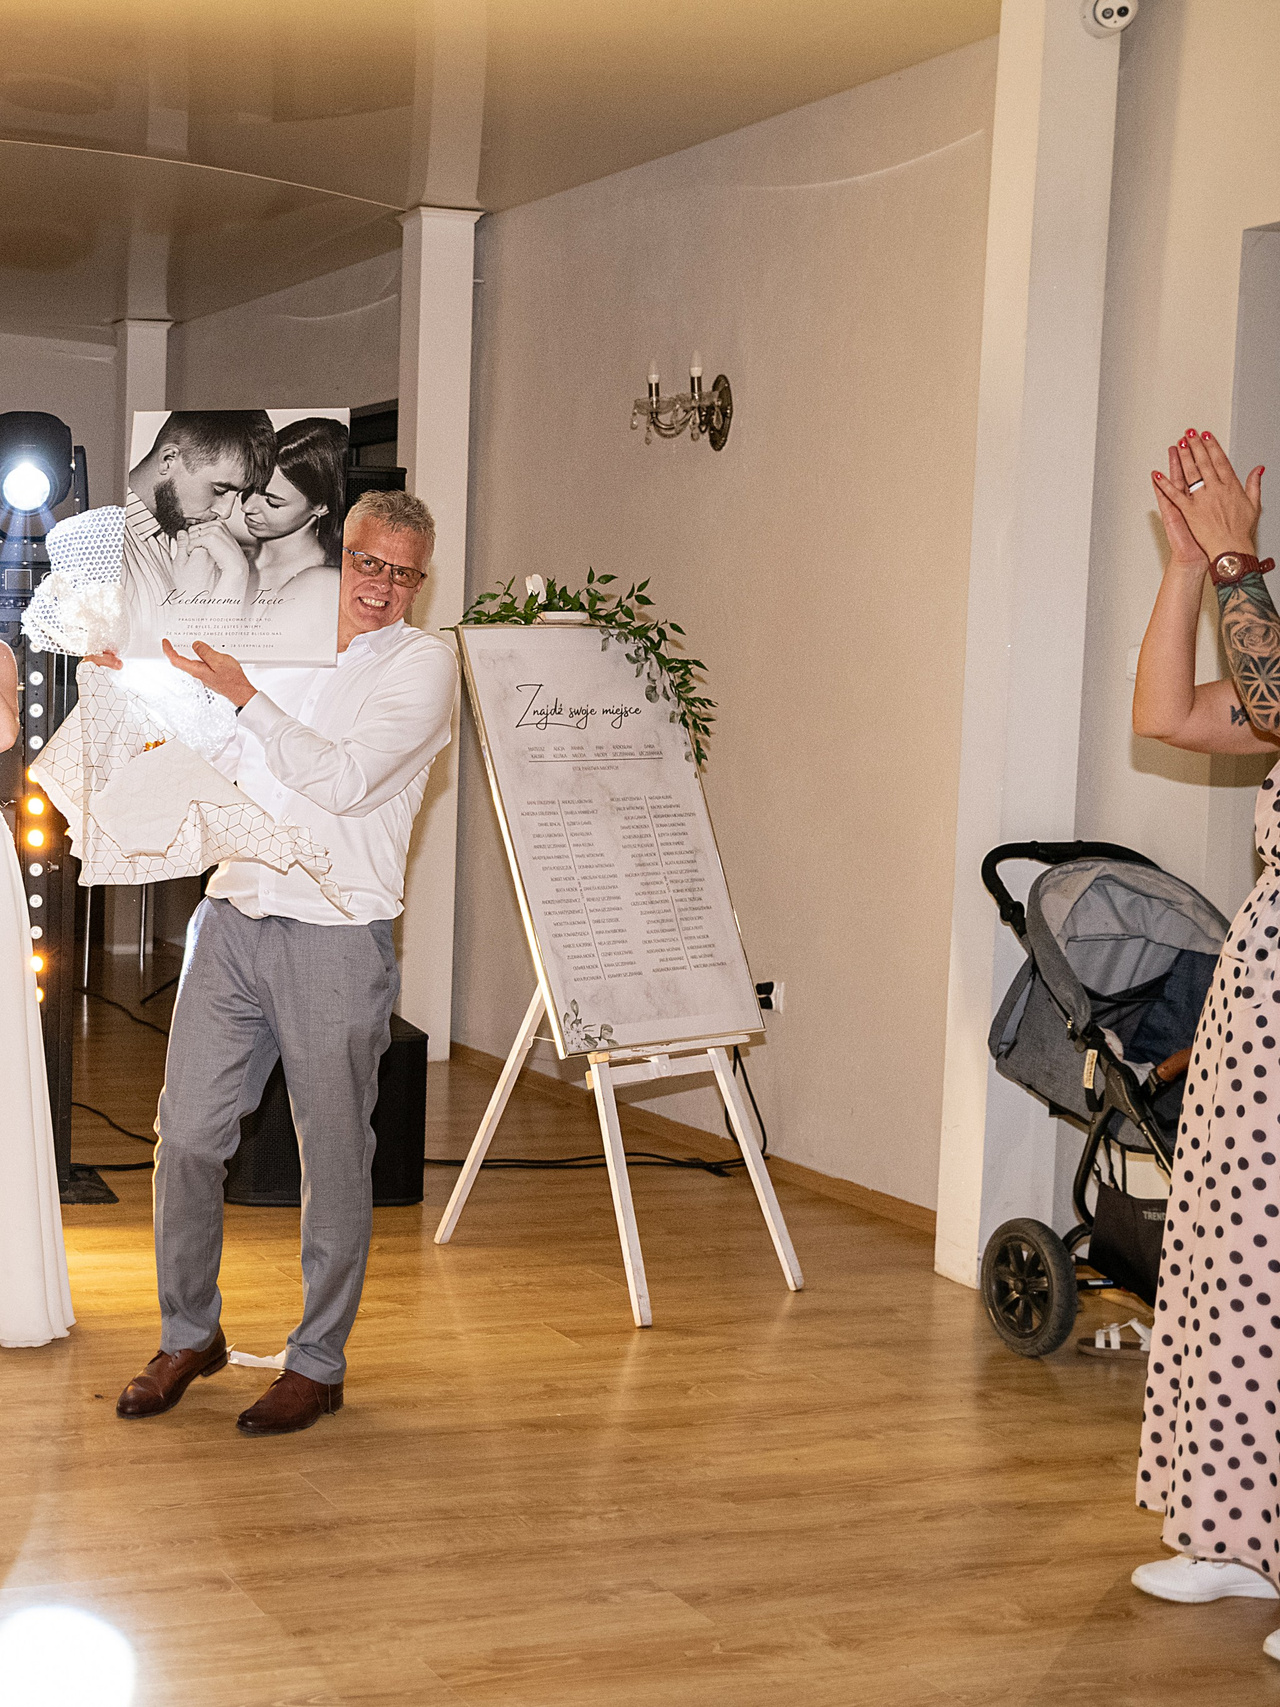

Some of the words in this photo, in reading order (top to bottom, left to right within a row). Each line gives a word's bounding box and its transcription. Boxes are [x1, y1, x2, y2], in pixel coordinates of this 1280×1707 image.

[157, 588, 241, 606] Kochanemu
[251, 588, 295, 605] Tacie
[516, 684, 579, 730] Znajdź
[569, 704, 597, 730] swoje
[602, 704, 642, 729] miejsce
